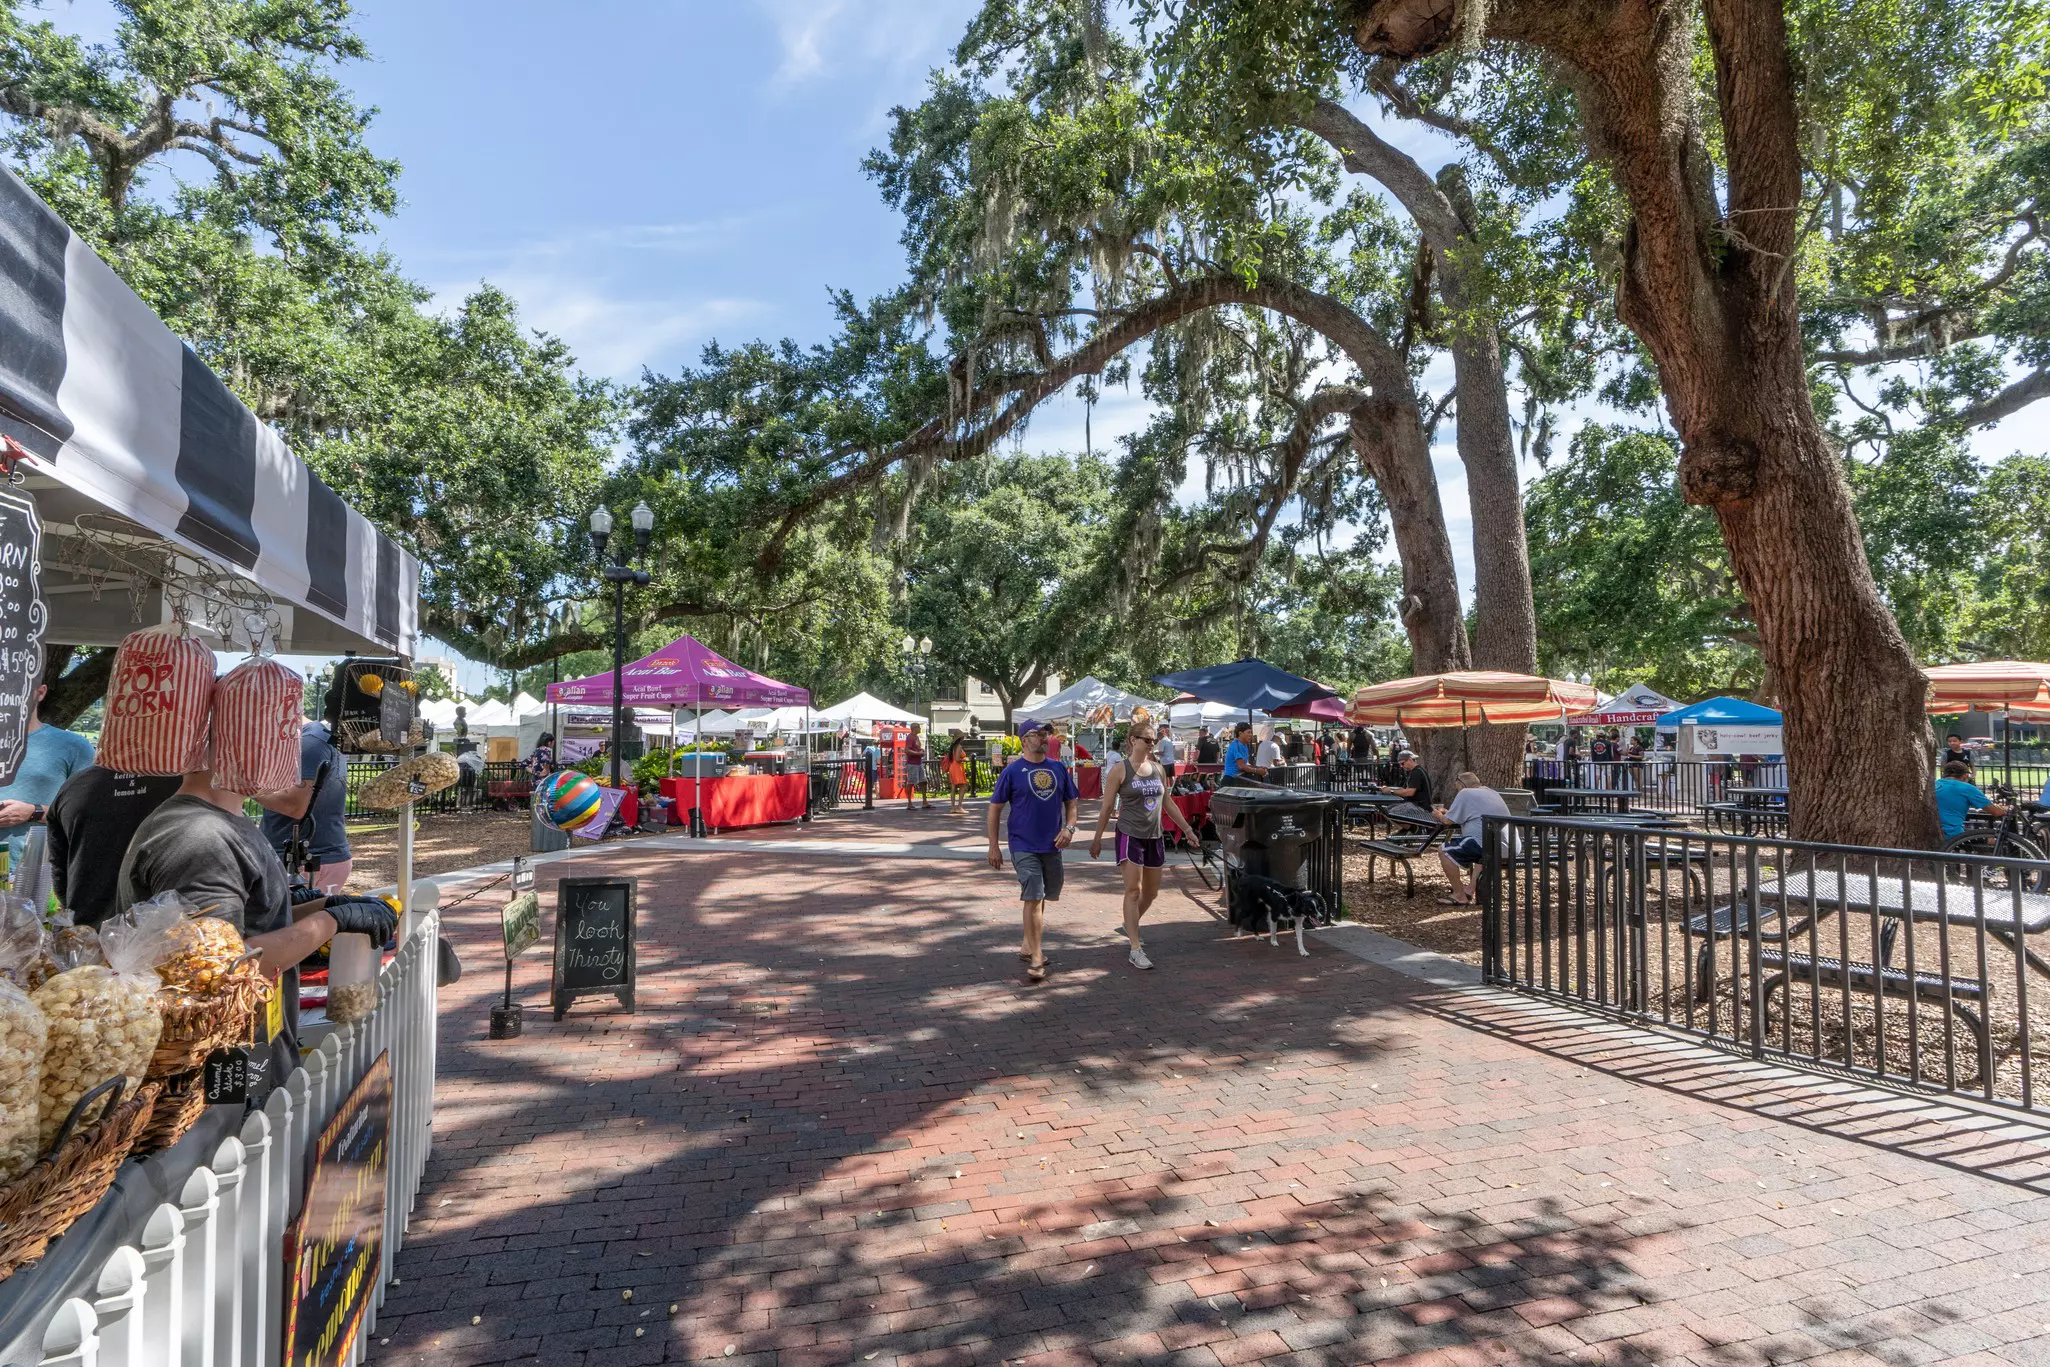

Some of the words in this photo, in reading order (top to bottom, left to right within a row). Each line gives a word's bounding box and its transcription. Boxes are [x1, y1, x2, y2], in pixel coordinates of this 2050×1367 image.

[117, 663, 175, 693] POP
[112, 691, 175, 717] CORN
[1142, 787, 1159, 796] CITY
[575, 892, 611, 918] You
[574, 919, 625, 940] look
[208, 1062, 223, 1100] Caramel
[233, 1059, 244, 1088] $3.00
